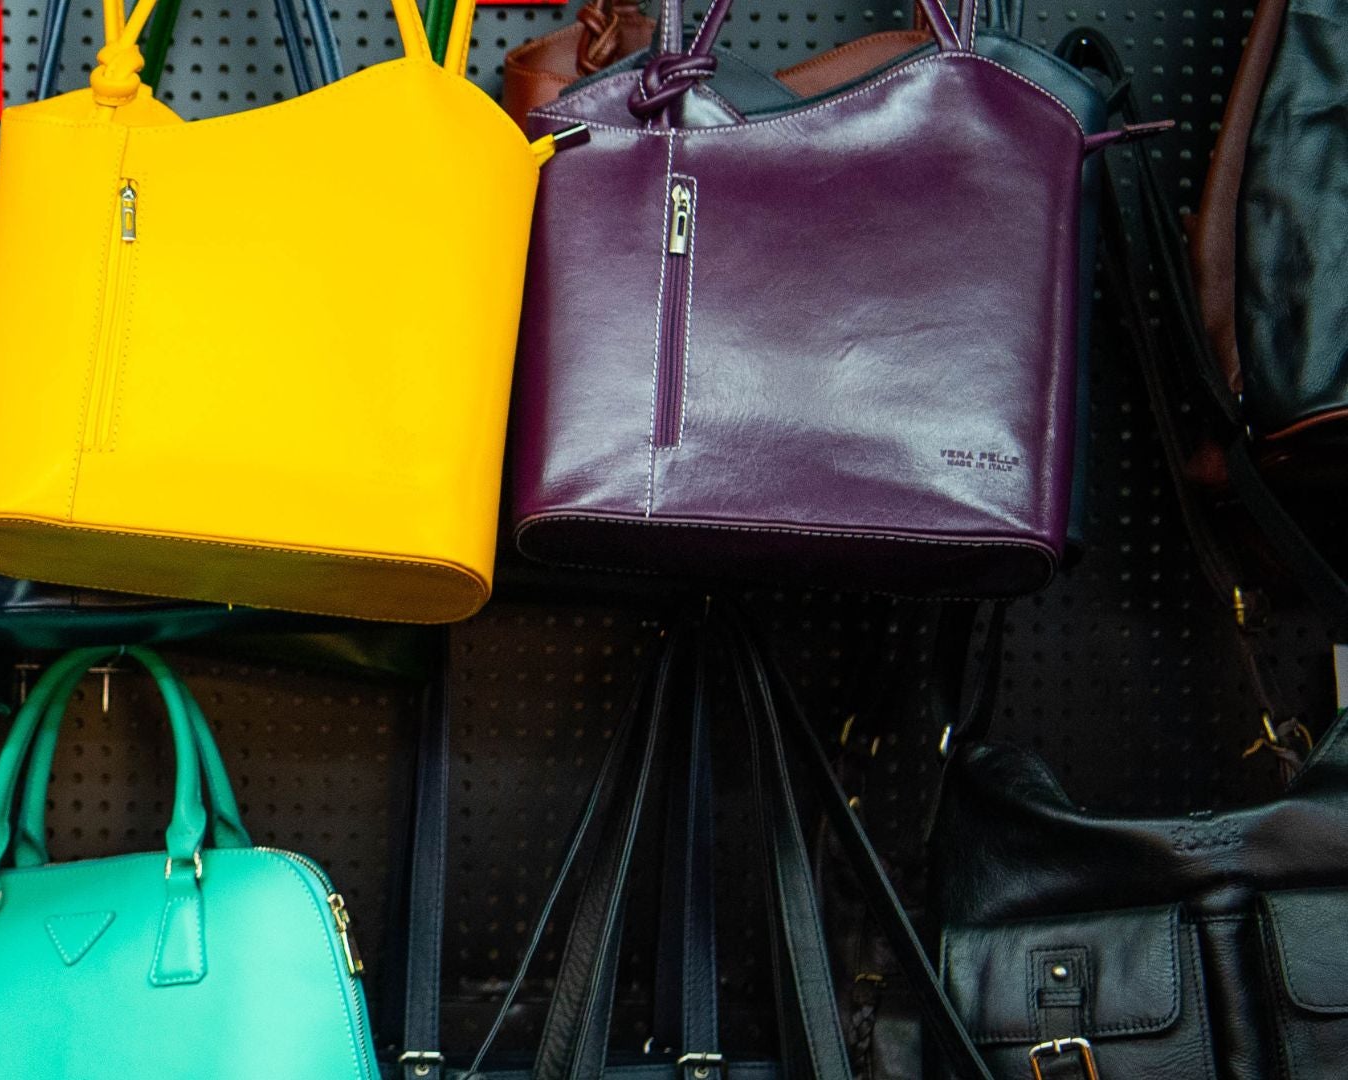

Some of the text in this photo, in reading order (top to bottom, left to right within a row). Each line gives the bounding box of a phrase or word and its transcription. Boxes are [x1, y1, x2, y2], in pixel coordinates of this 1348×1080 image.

[940, 449, 1019, 466] VERA PELLE
[947, 459, 1012, 472] MADE IN ITALY
